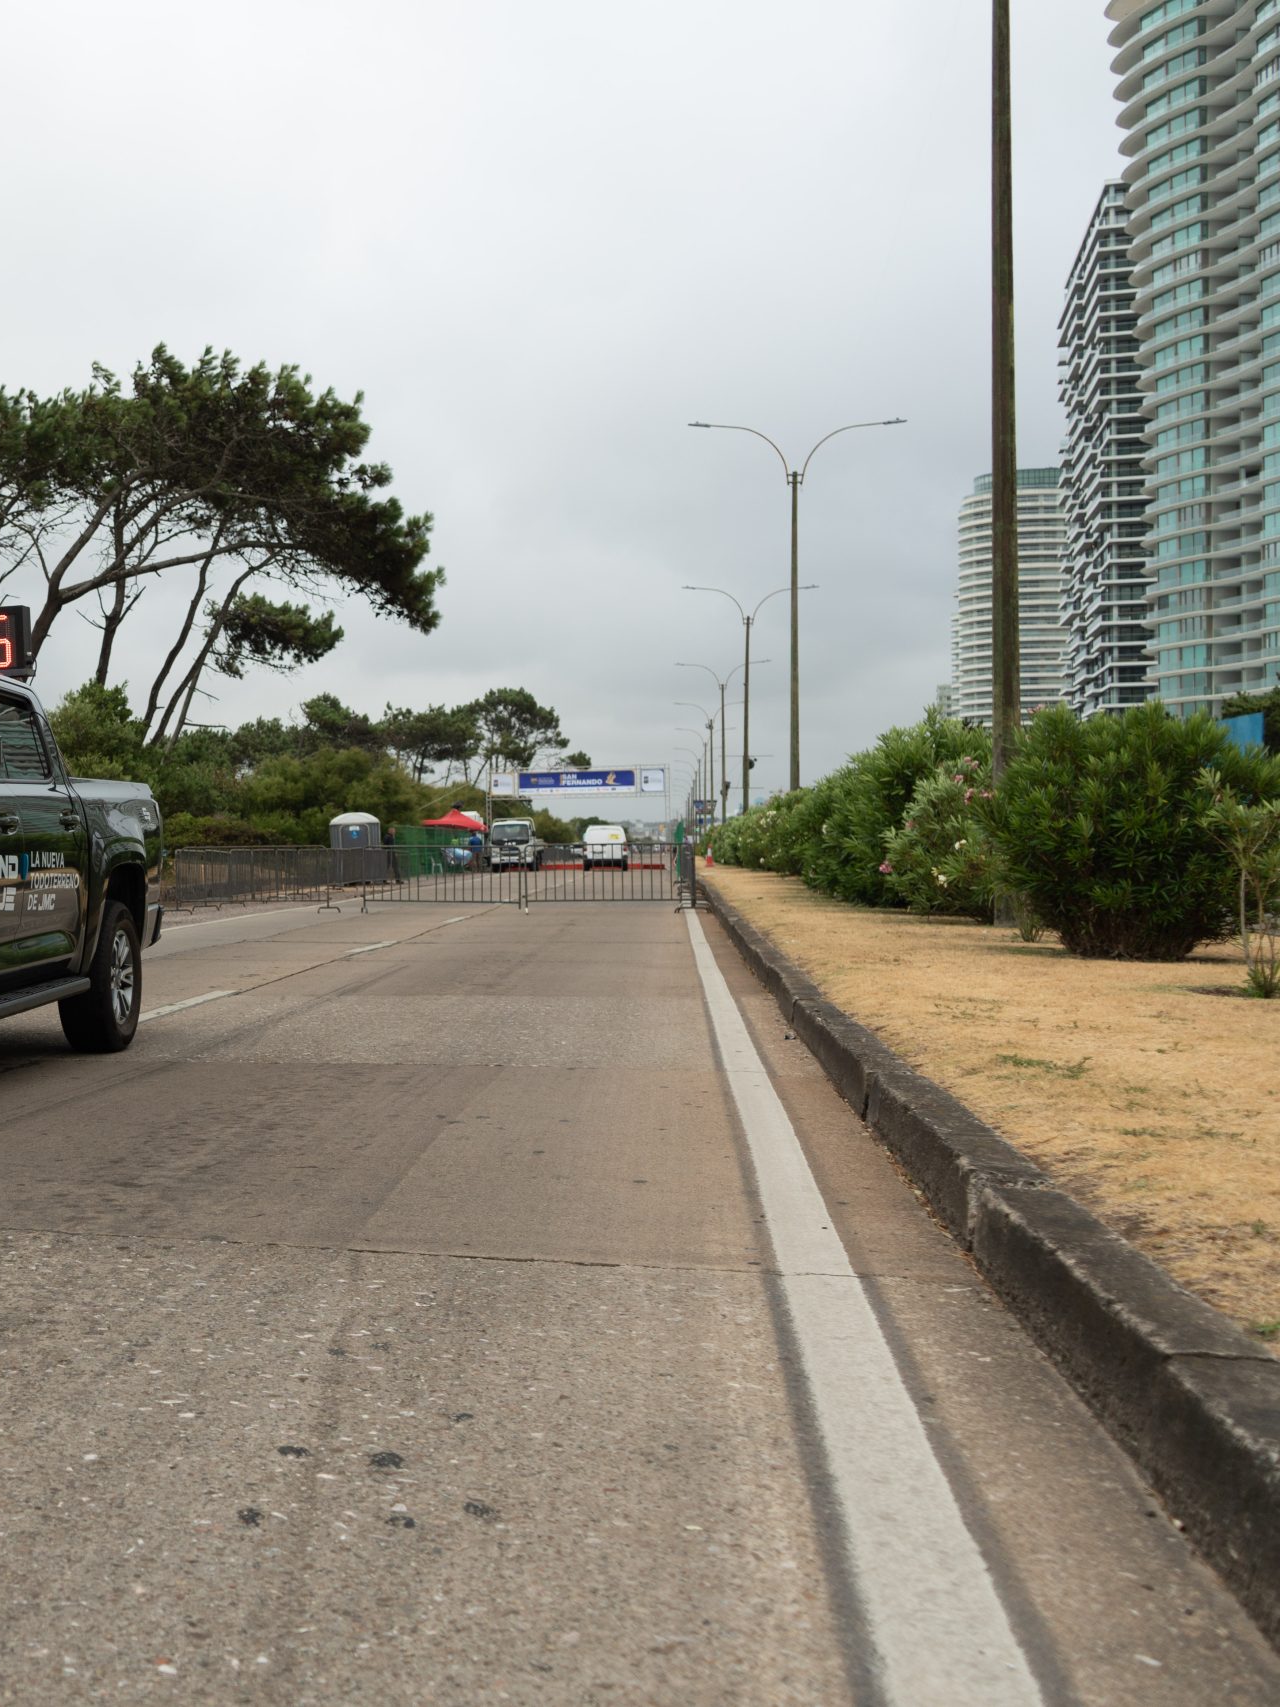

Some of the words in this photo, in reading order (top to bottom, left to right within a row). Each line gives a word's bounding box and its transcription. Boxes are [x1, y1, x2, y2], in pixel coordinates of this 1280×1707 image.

[562, 778, 603, 786] FERNANDO
[30, 851, 40, 868] LA
[41, 851, 65, 868] NUEVA
[30, 872, 80, 889] TODOTERRENO
[27, 894, 38, 910] DE
[38, 893, 56, 911] JMC
